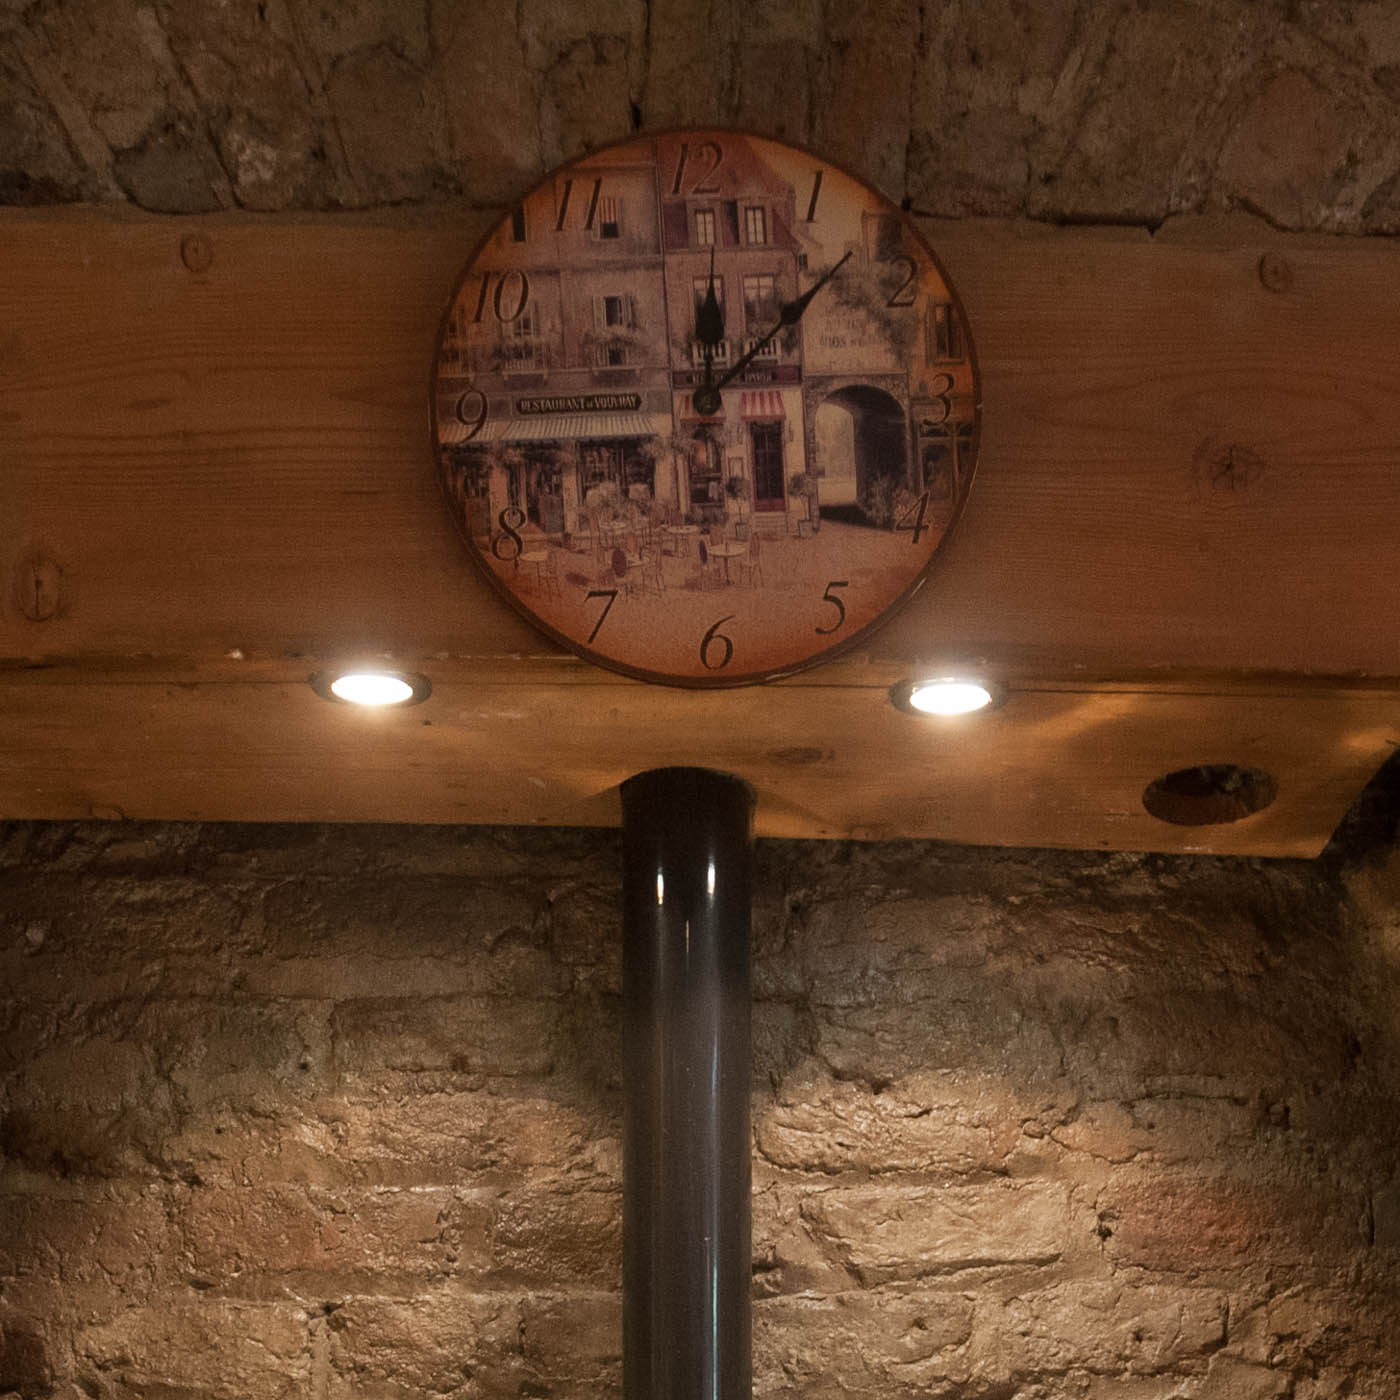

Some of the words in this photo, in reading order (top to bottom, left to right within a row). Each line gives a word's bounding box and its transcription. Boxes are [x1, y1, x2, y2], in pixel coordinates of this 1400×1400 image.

[671, 142, 724, 195] 12
[555, 178, 602, 232] 11
[806, 170, 824, 223] 1
[473, 269, 531, 324] 10
[886, 255, 919, 309] 2
[455, 389, 489, 444] 9
[923, 372, 955, 426] 3
[491, 507, 526, 562] 8
[894, 491, 931, 545] 4
[583, 589, 619, 645] 7
[815, 581, 850, 635] 5
[699, 615, 736, 670] 6
